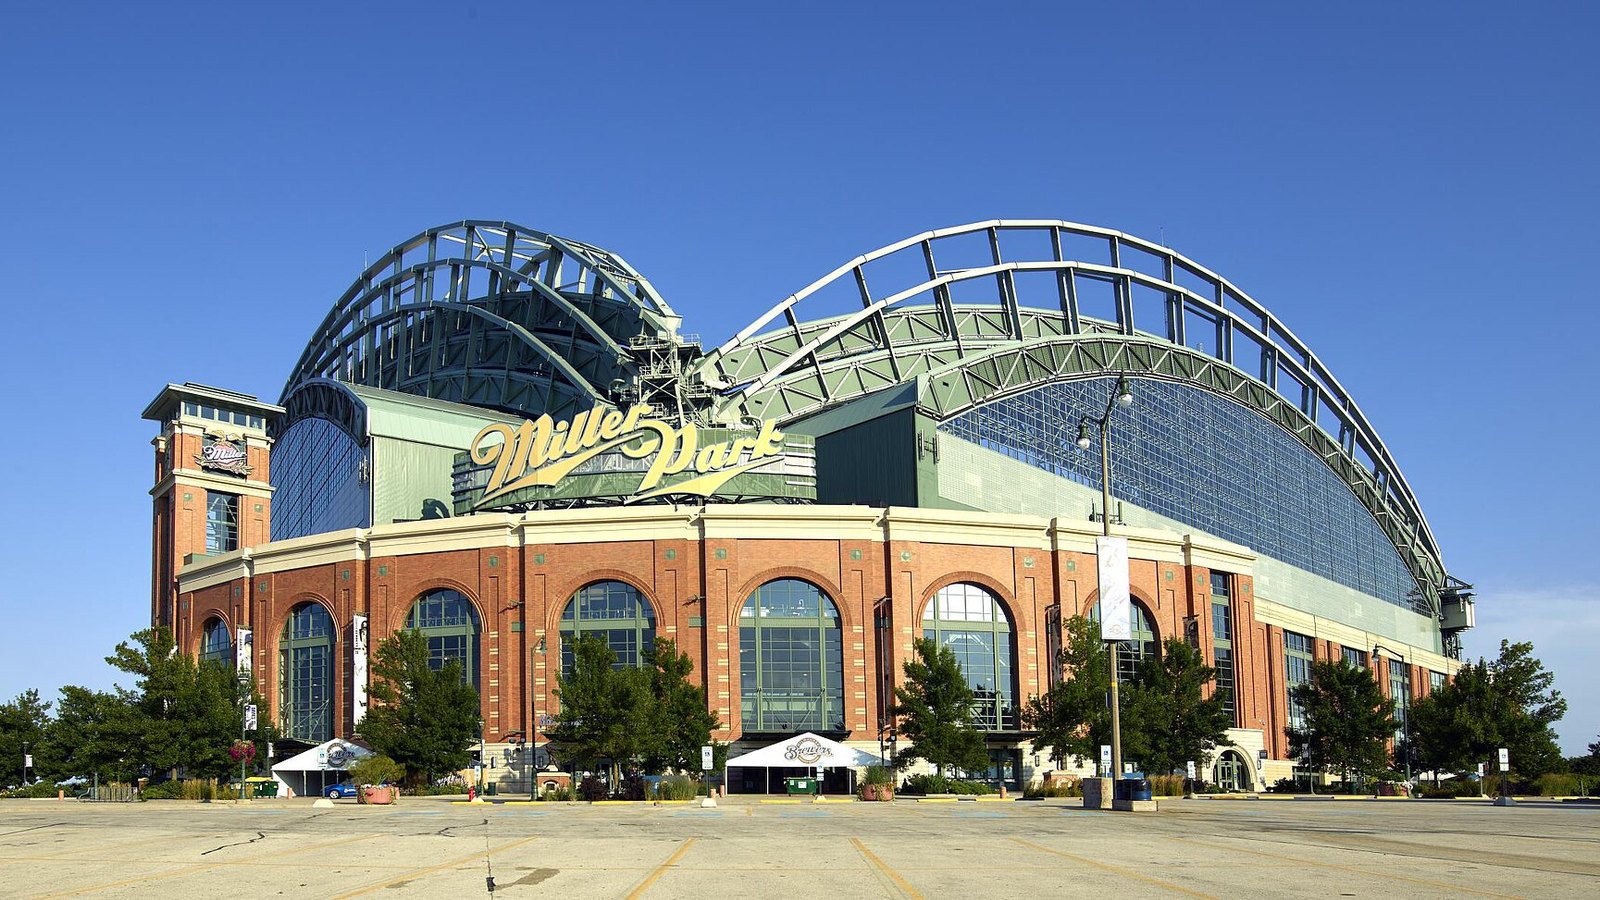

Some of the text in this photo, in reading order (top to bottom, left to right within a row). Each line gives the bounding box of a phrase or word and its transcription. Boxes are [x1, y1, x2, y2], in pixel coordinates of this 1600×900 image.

[203, 445, 248, 463] Miller
[470, 404, 785, 506] Miller Park
[784, 745, 834, 760] Brewers
